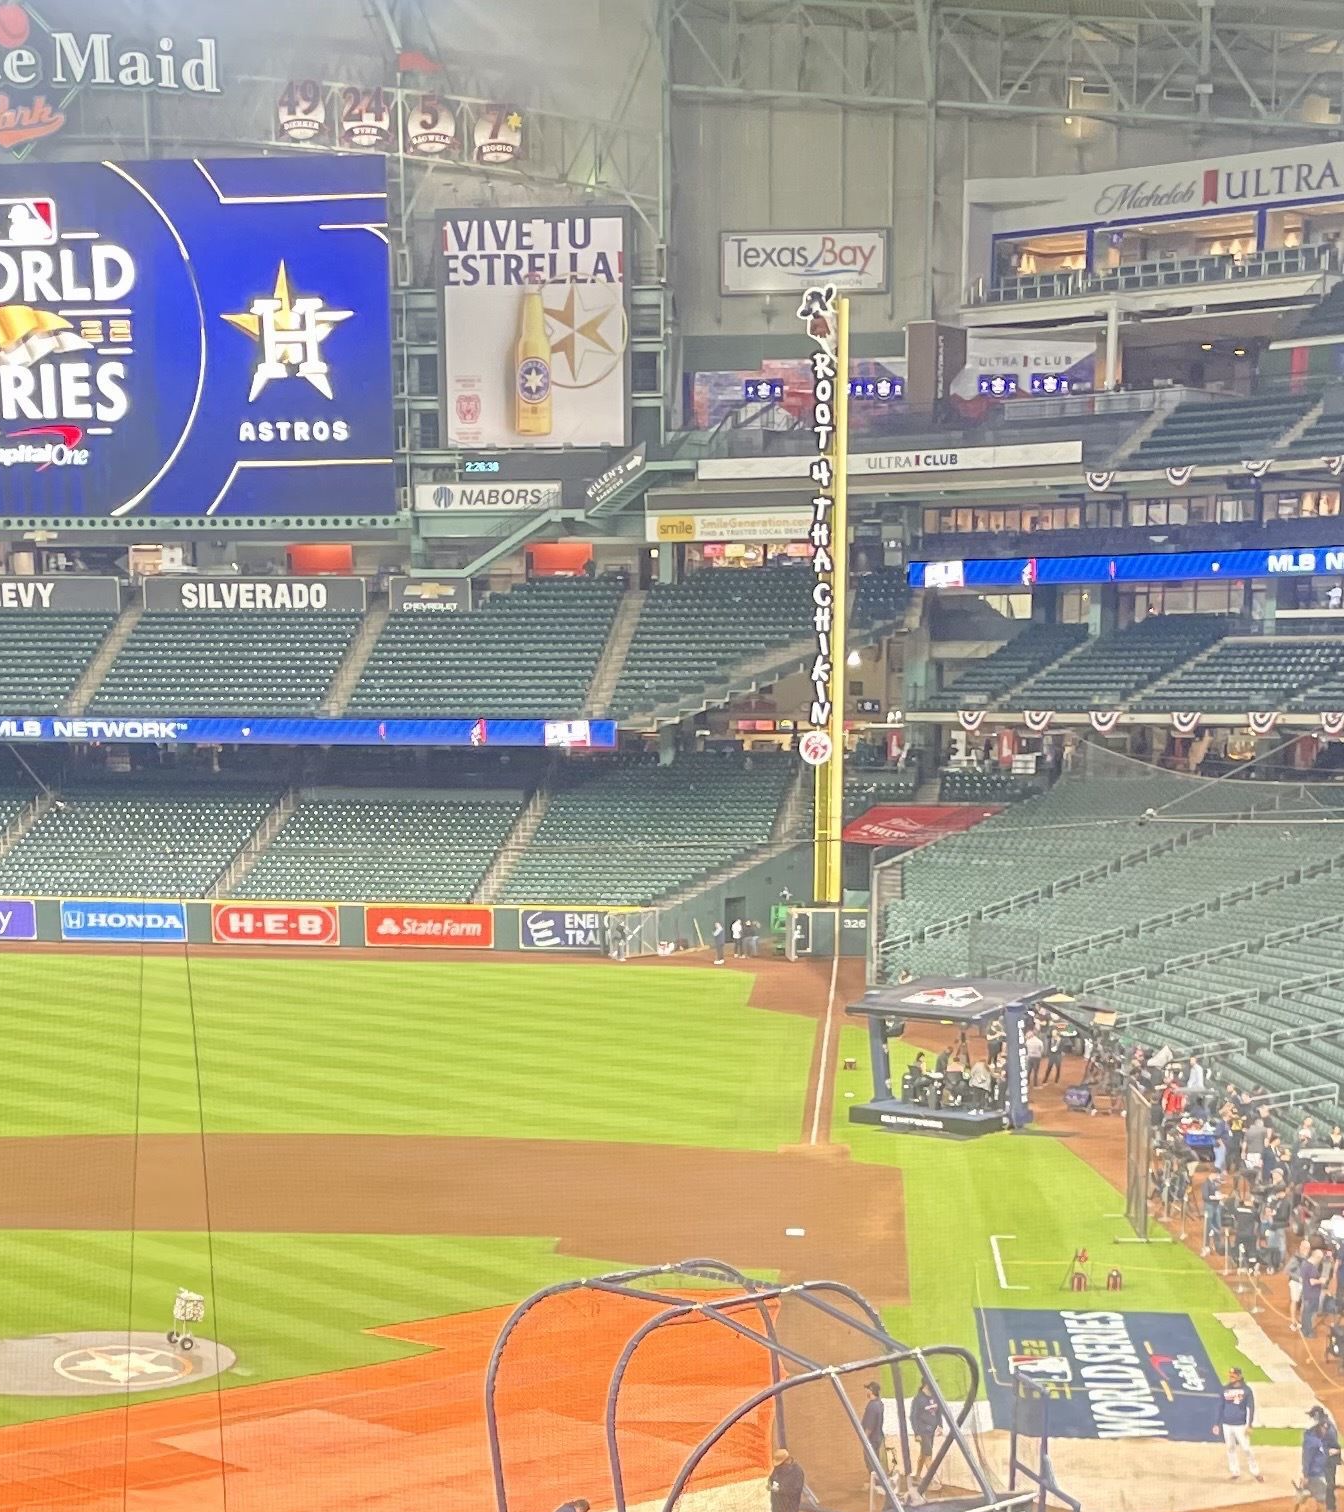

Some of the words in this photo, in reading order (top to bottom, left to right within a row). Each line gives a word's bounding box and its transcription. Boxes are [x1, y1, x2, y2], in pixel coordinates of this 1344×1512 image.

[52, 33, 221, 93] Maid
[278, 80, 322, 115] 49
[342, 87, 387, 122] 24
[419, 94, 439, 129] 5
[487, 104, 507, 139] 7
[1095, 181, 1196, 216] Michelob
[1226, 159, 1341, 200] ULTRA
[544, 218, 591, 249] TU
[447, 251, 623, 286] ESTRELLA!
[731, 238, 808, 267] Texas
[822, 236, 876, 276] Bay
[979, 356, 1018, 367] ULTRA
[1034, 355, 1072, 366] CLUB
[813, 353, 835, 449] ROOT
[239, 421, 349, 442] ASTROS
[811, 461, 831, 487] 4
[868, 457, 912, 471] ULTRA
[924, 454, 958, 467] CLUB
[460, 488, 542, 505] NABORS
[660, 521, 693, 535] smile
[811, 497, 832, 573] THA
[1268, 552, 1315, 573] MLB
[181, 582, 327, 609] SILVERADO
[811, 582, 832, 725] CHIKIN
[88, 913, 184, 929] HONDA
[843, 918, 866, 929] 326
[1060, 1310, 1140, 1365] SERIES
[1080, 1364, 1168, 1439] WORLD
